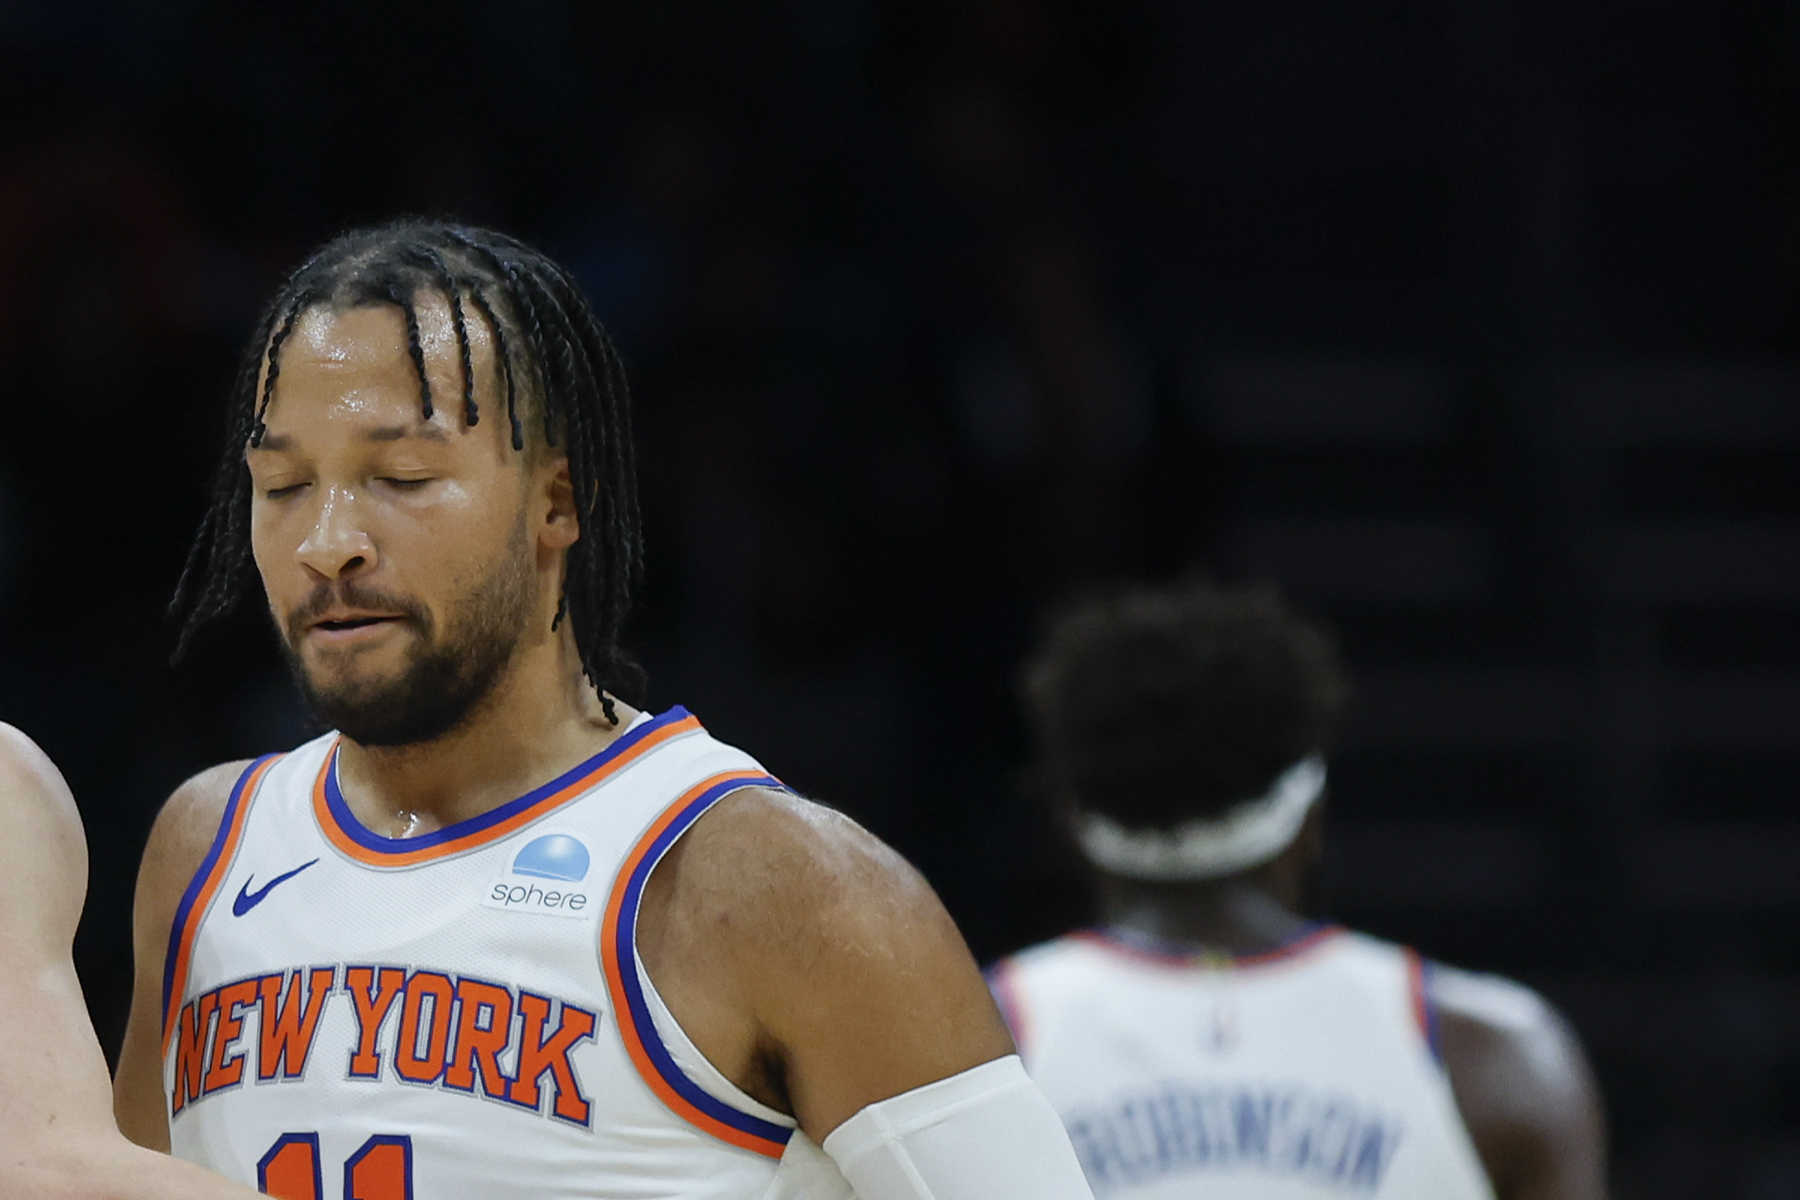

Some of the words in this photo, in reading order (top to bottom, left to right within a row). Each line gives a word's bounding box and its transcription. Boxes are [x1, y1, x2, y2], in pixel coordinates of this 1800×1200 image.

[491, 883, 587, 911] sphere
[171, 964, 338, 1121] NEW
[344, 962, 600, 1130] YORK
